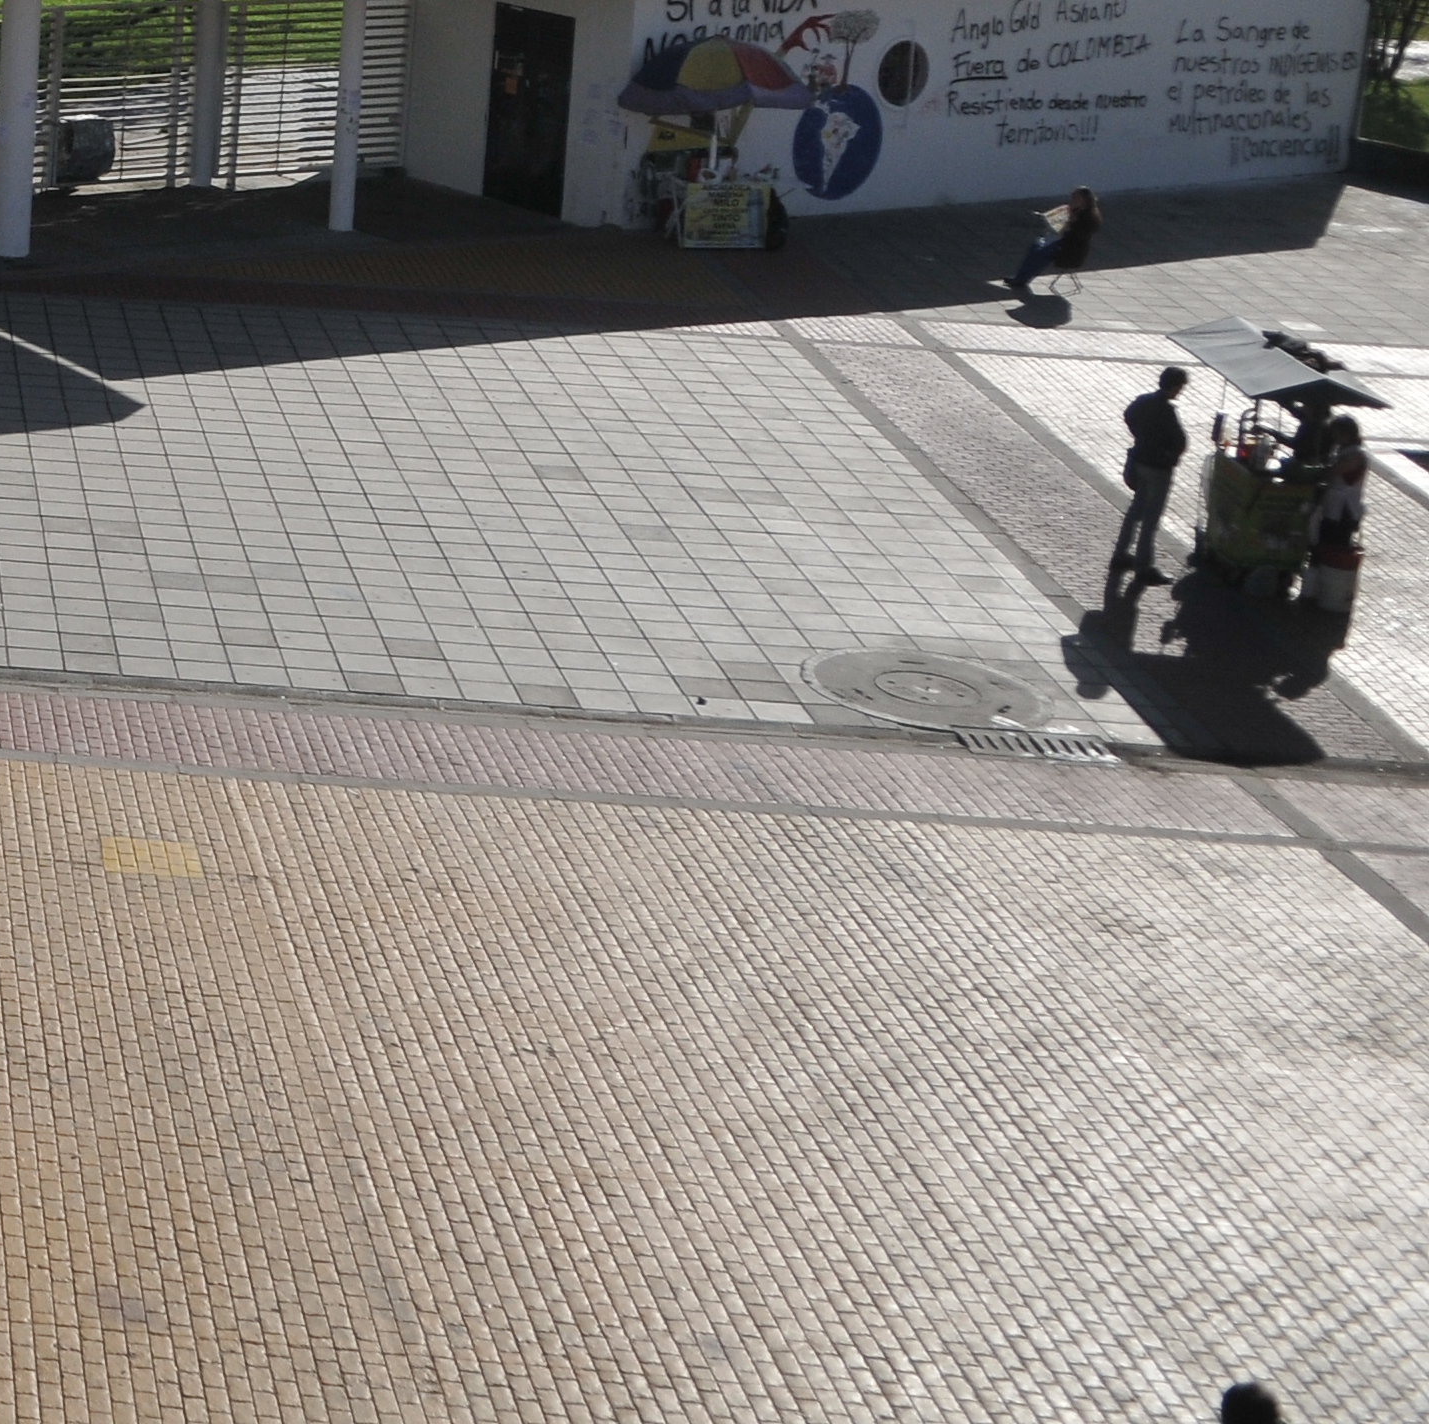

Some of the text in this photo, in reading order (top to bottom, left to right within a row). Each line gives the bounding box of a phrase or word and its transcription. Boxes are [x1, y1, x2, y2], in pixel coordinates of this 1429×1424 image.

[735, 16, 785, 43] mina
[950, 8, 1004, 50] Anglo
[1175, 16, 1311, 48] La Sangre de
[951, 33, 1151, 78] Fuera de COLOMBIA
[1173, 48, 1261, 74] nuestros
[947, 88, 1147, 118] Resistiendo desde nuestro
[1166, 80, 1183, 105] el
[1274, 81, 1291, 105] de
[1306, 80, 1331, 108] las
